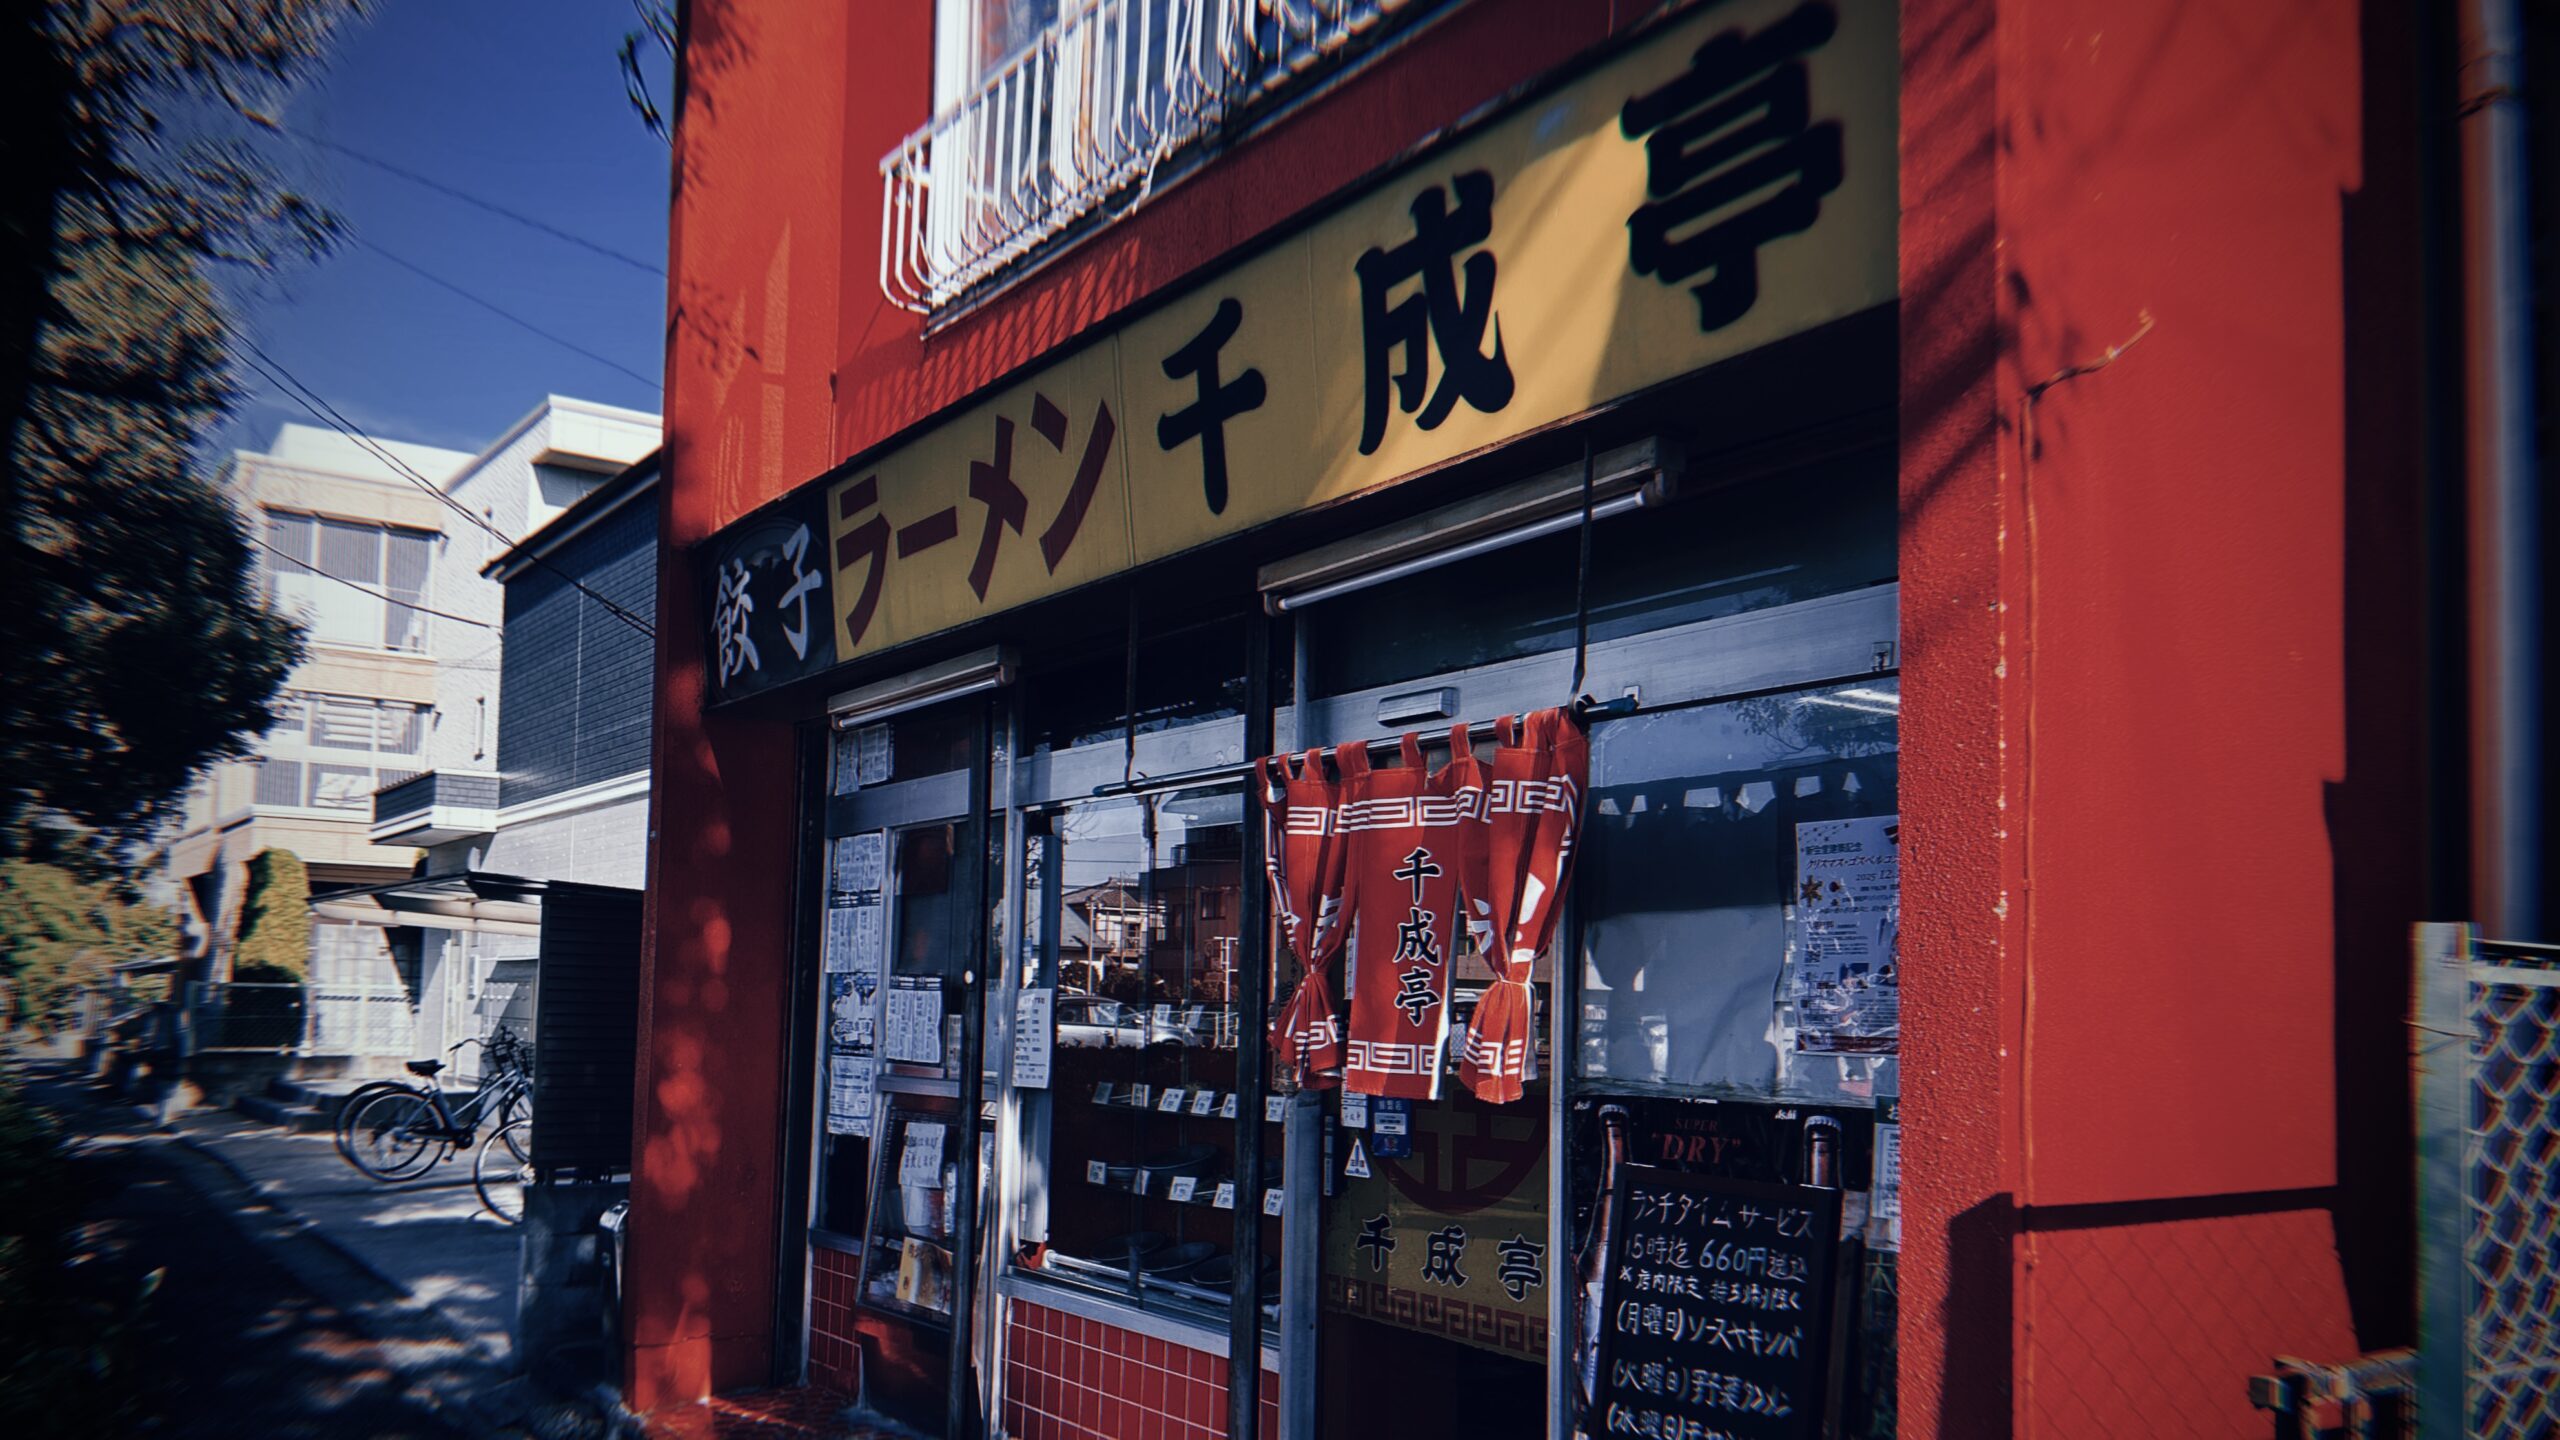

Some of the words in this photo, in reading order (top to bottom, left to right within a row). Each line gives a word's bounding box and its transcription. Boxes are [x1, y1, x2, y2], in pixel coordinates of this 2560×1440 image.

[836, 392, 1116, 646] ラーメン
[1157, 0, 1846, 517] 千成亭
[710, 523, 823, 688] 餃子
[1392, 846, 1442, 1027] 千成亭
[1673, 1117, 1719, 1132] SUPER
[1355, 1213, 1547, 1303] 千成亭
